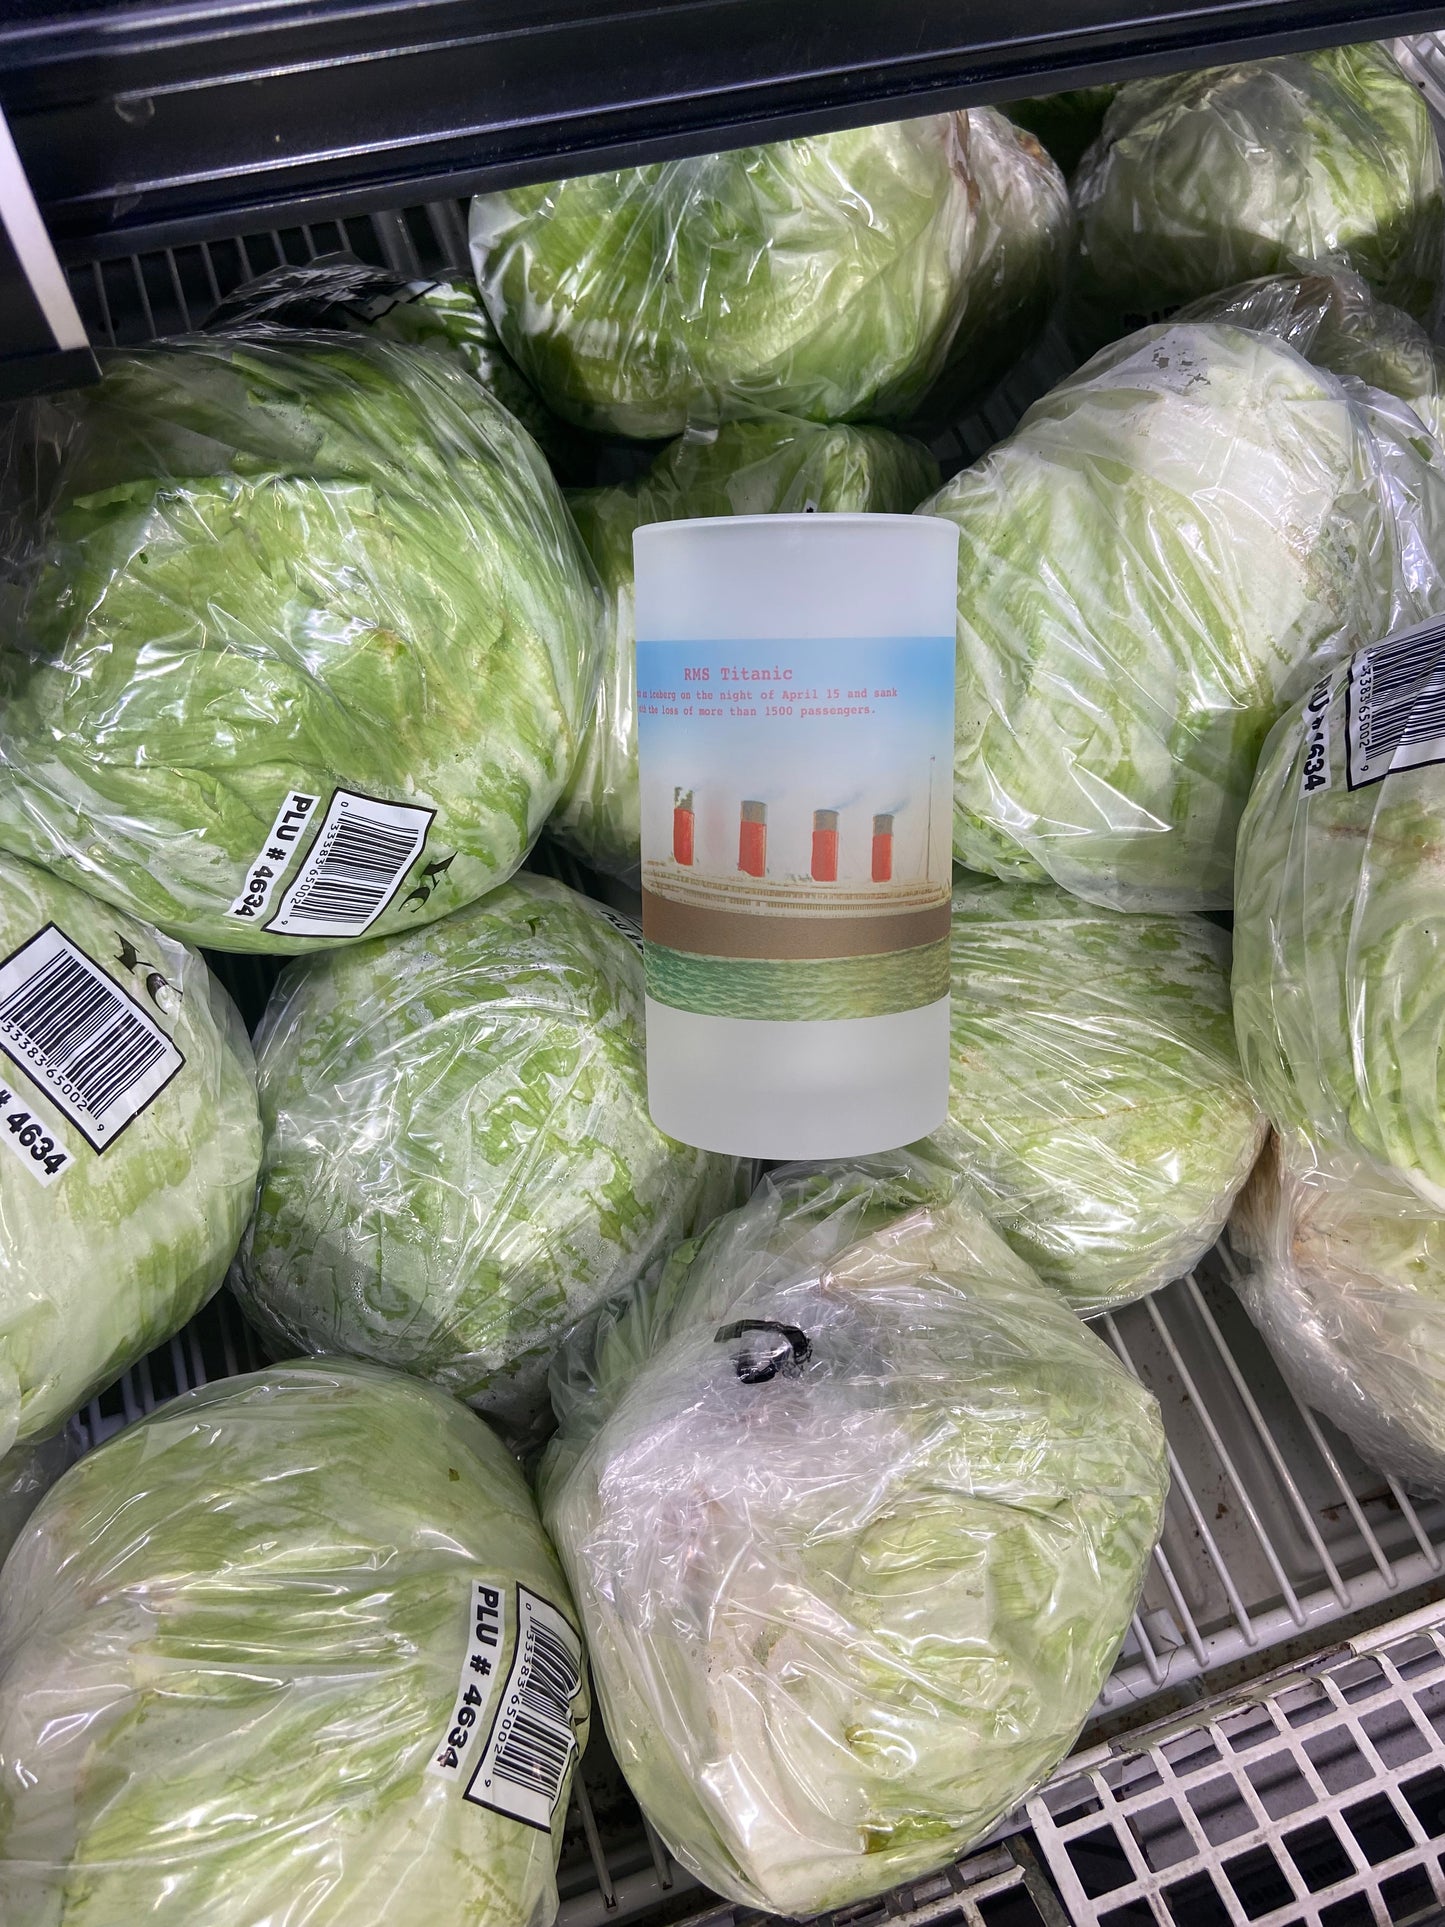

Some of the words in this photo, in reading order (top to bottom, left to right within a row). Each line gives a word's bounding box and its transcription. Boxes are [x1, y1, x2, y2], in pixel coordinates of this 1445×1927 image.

[649, 689, 676, 701] iceberg
[680, 691, 691, 700] on
[696, 690, 713, 700] the
[720, 690, 753, 702] night
[761, 690, 775, 700] of
[782, 688, 819, 702] April
[827, 688, 840, 699] 15
[847, 687, 868, 698] and
[874, 686, 898, 698] sank
[684, 667, 710, 681] RMS
[720, 665, 793, 681] Titanic
[649, 705, 659, 714] the
[662, 705, 679, 715] loss
[683, 706, 694, 715] of
[699, 708, 723, 716] more
[730, 706, 757, 716] than
[765, 706, 793, 716] 1500
[801, 704, 876, 718] passengers.
[1358, 706, 1371, 749] 65002
[276, 795, 314, 841] PLU
[266, 847, 288, 860] #
[315, 823, 340, 865] 33383
[234, 865, 275, 917] 4634
[290, 869, 319, 905] 65002
[46, 1068, 88, 1112] 65002
[97, 1123, 105, 1131] 9
[6, 1112, 68, 1175] 4634
[476, 1585, 500, 1647] PLU
[525, 1603, 532, 1611] 0
[470, 1654, 491, 1676] #
[517, 1630, 535, 1688] 33383
[437, 1684, 482, 1769] 4634
[494, 1694, 520, 1755] 65002
[484, 1779, 491, 1787] 9
